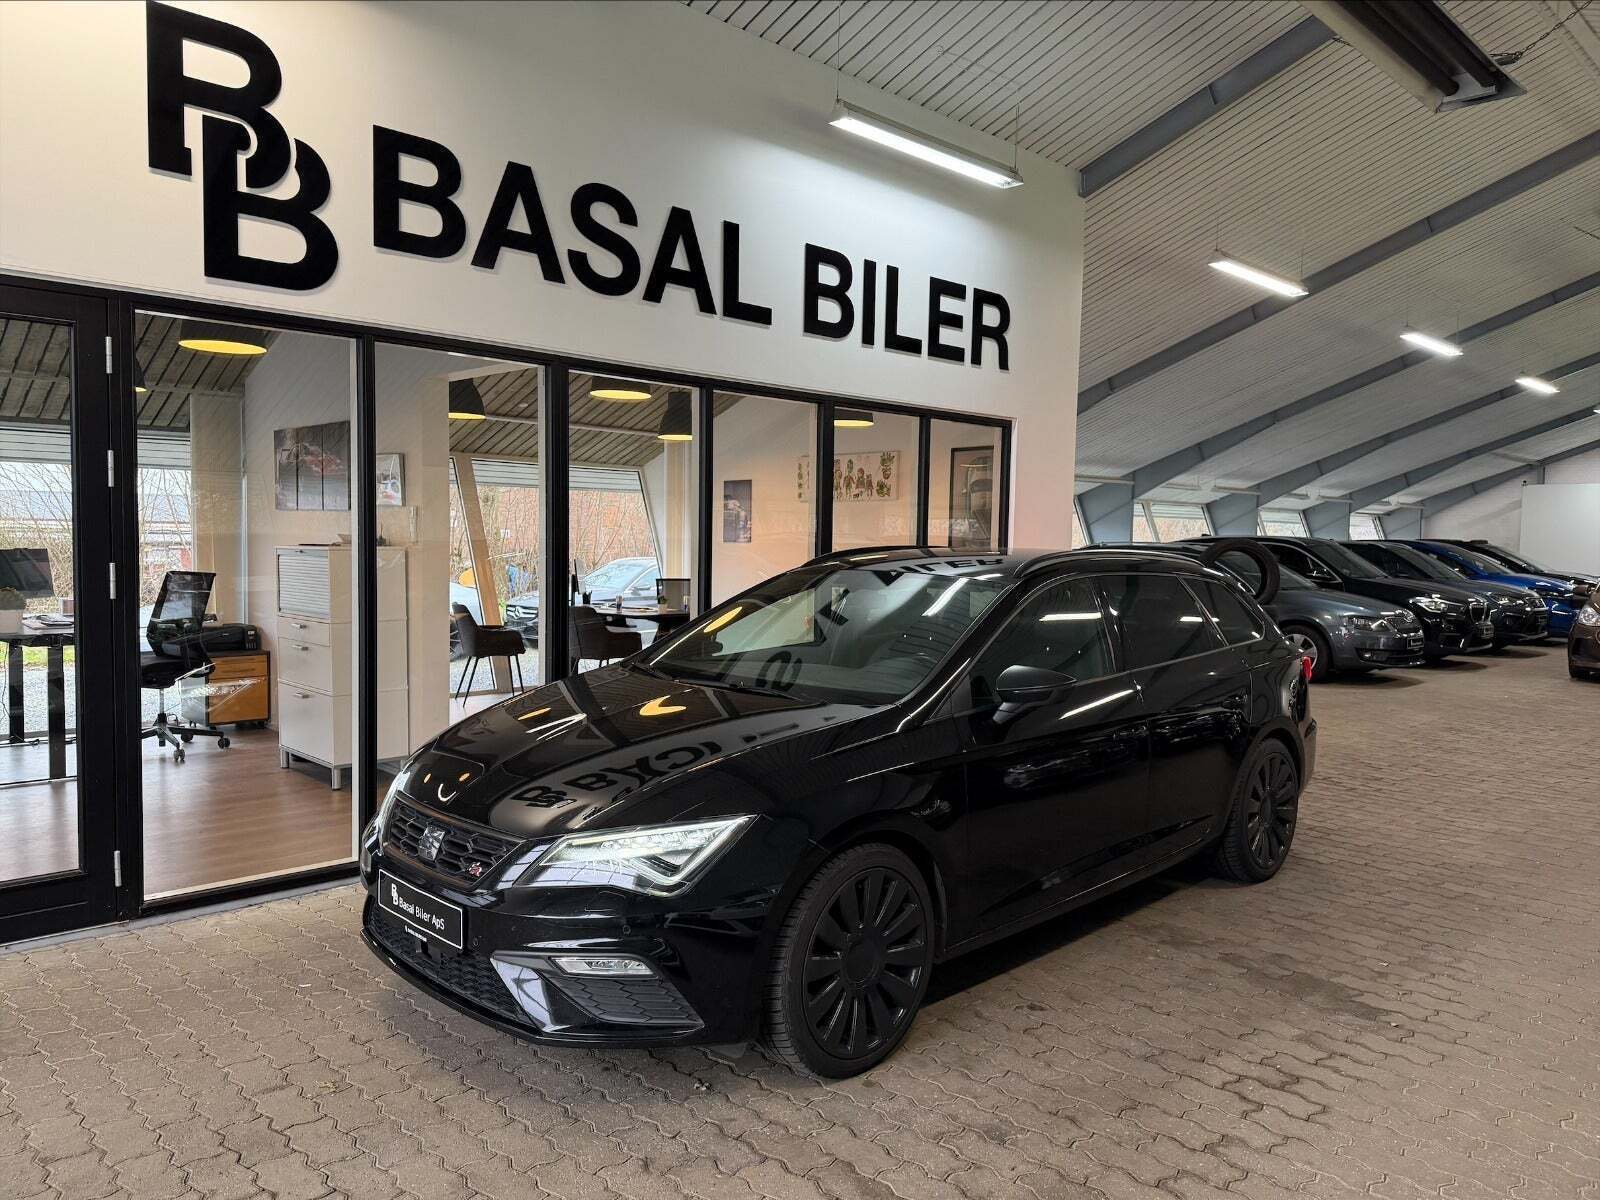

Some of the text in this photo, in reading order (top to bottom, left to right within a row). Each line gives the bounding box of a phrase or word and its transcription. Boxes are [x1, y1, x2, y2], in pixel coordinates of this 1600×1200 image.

[372, 124, 1010, 371] BASAL BILER
[399, 898, 415, 915] Basal
[415, 906, 431, 922] Biler
[431, 914, 445, 930] ApS
